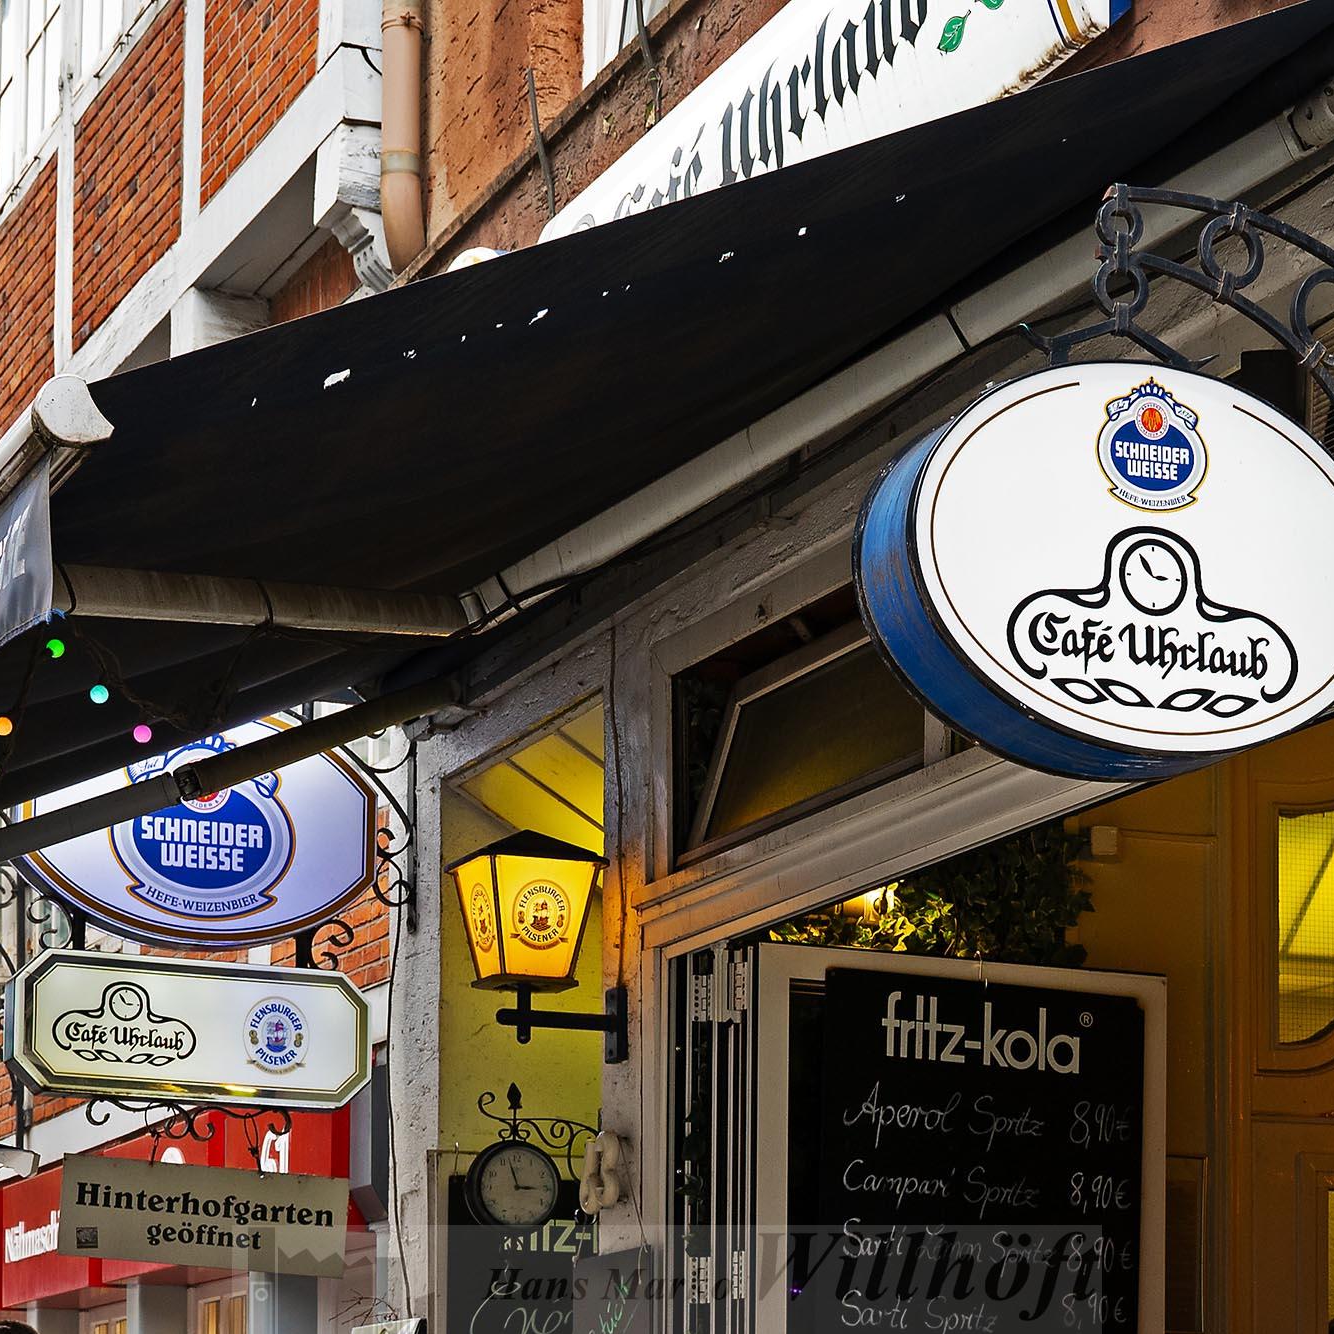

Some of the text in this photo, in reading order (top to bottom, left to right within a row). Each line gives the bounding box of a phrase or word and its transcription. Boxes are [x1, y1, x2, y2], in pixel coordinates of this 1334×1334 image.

[1115, 440, 1190, 465] SCHNEIDER
[1127, 459, 1178, 481] WEISSE
[1119, 488, 1187, 508] HEFE-WEIZENBIER
[1028, 611, 1269, 681] Café Uhrlaub
[141, 815, 263, 849] SCHNEIDER
[160, 844, 244, 872] WEISSE
[146, 884, 259, 912] HEFE-WEIZENBIER
[519, 885, 566, 912] FLENSBURGER
[522, 925, 560, 943] PILSENER
[250, 1003, 303, 1034] FLENSBURGER
[882, 991, 1080, 1074] fritz-kola
[66, 1022, 184, 1052] Café Uhrlaub
[254, 1045, 299, 1067] PILSENER
[843, 1081, 961, 1149] Aperol
[969, 1095, 1045, 1152] Spritz
[75, 1181, 335, 1228] Hinterhofgarten
[843, 1159, 956, 1209] Campari
[963, 1166, 1039, 1220] Spritz
[146, 1221, 262, 1251] geöffnet
